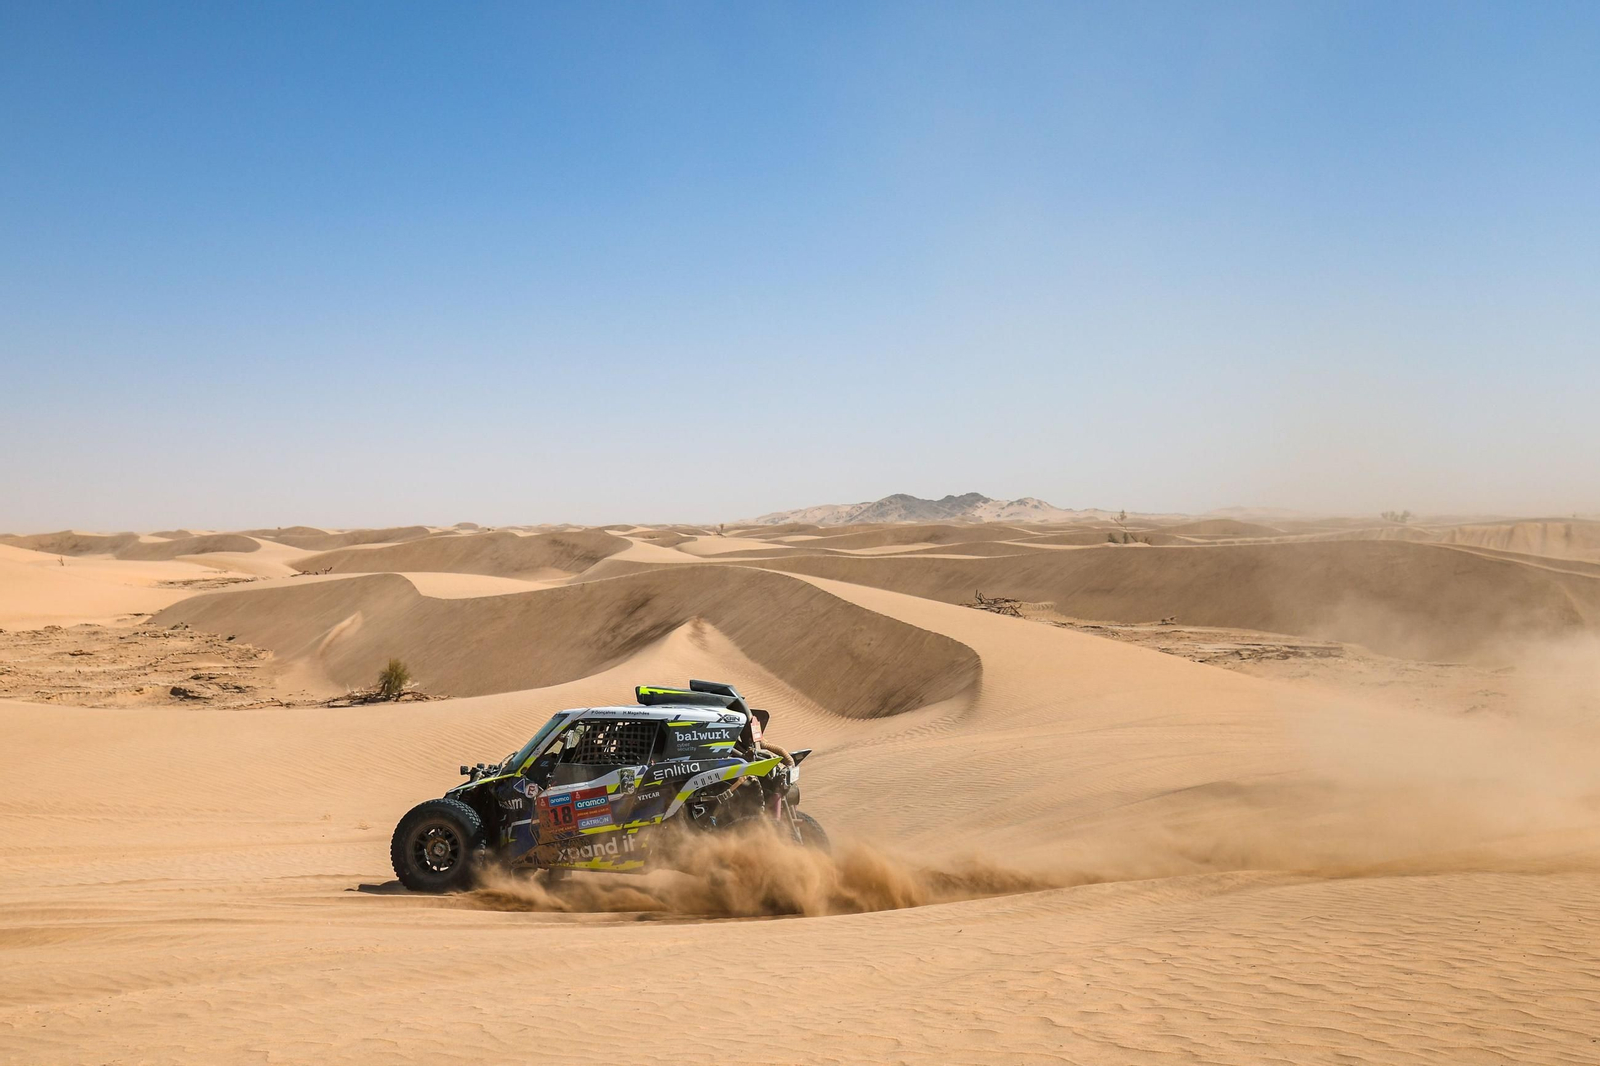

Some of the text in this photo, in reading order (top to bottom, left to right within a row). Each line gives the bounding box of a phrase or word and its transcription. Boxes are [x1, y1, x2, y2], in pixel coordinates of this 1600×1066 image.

[675, 729, 731, 742] balwurk
[550, 796, 570, 804] aramco
[577, 797, 606, 808] aramco
[581, 817, 610, 827] CATRION
[622, 834, 636, 852] it
